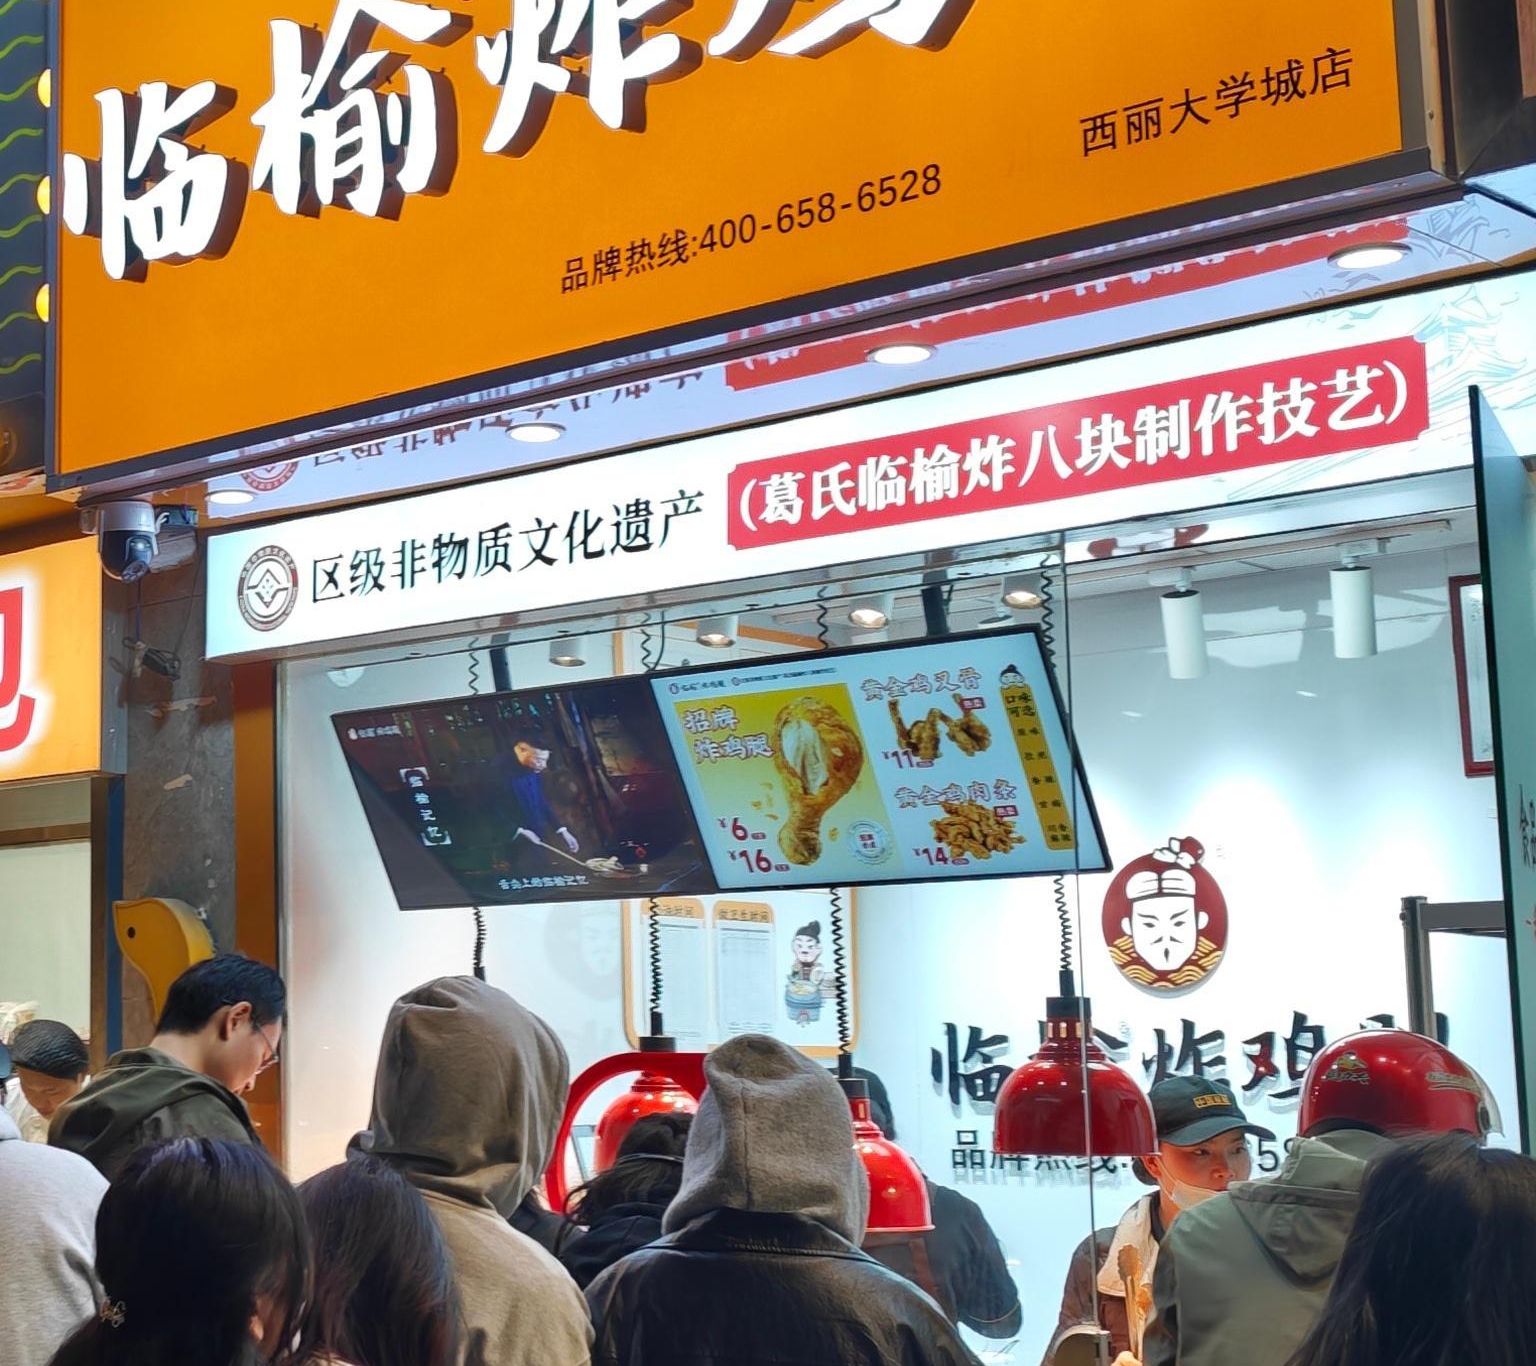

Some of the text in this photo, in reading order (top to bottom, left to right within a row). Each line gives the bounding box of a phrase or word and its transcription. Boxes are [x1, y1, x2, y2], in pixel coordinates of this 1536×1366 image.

[1079, 46, 1354, 158] 西丽大学城店
[561, 162, 943, 294] 品牌热线:400-658-6528
[311, 488, 706, 604] 区级非物质文化遗产
[684, 704, 740, 734] 招牌
[694, 731, 775, 765] 炸鸡腿
[931, 1010, 1448, 1105] 临炸鸡
